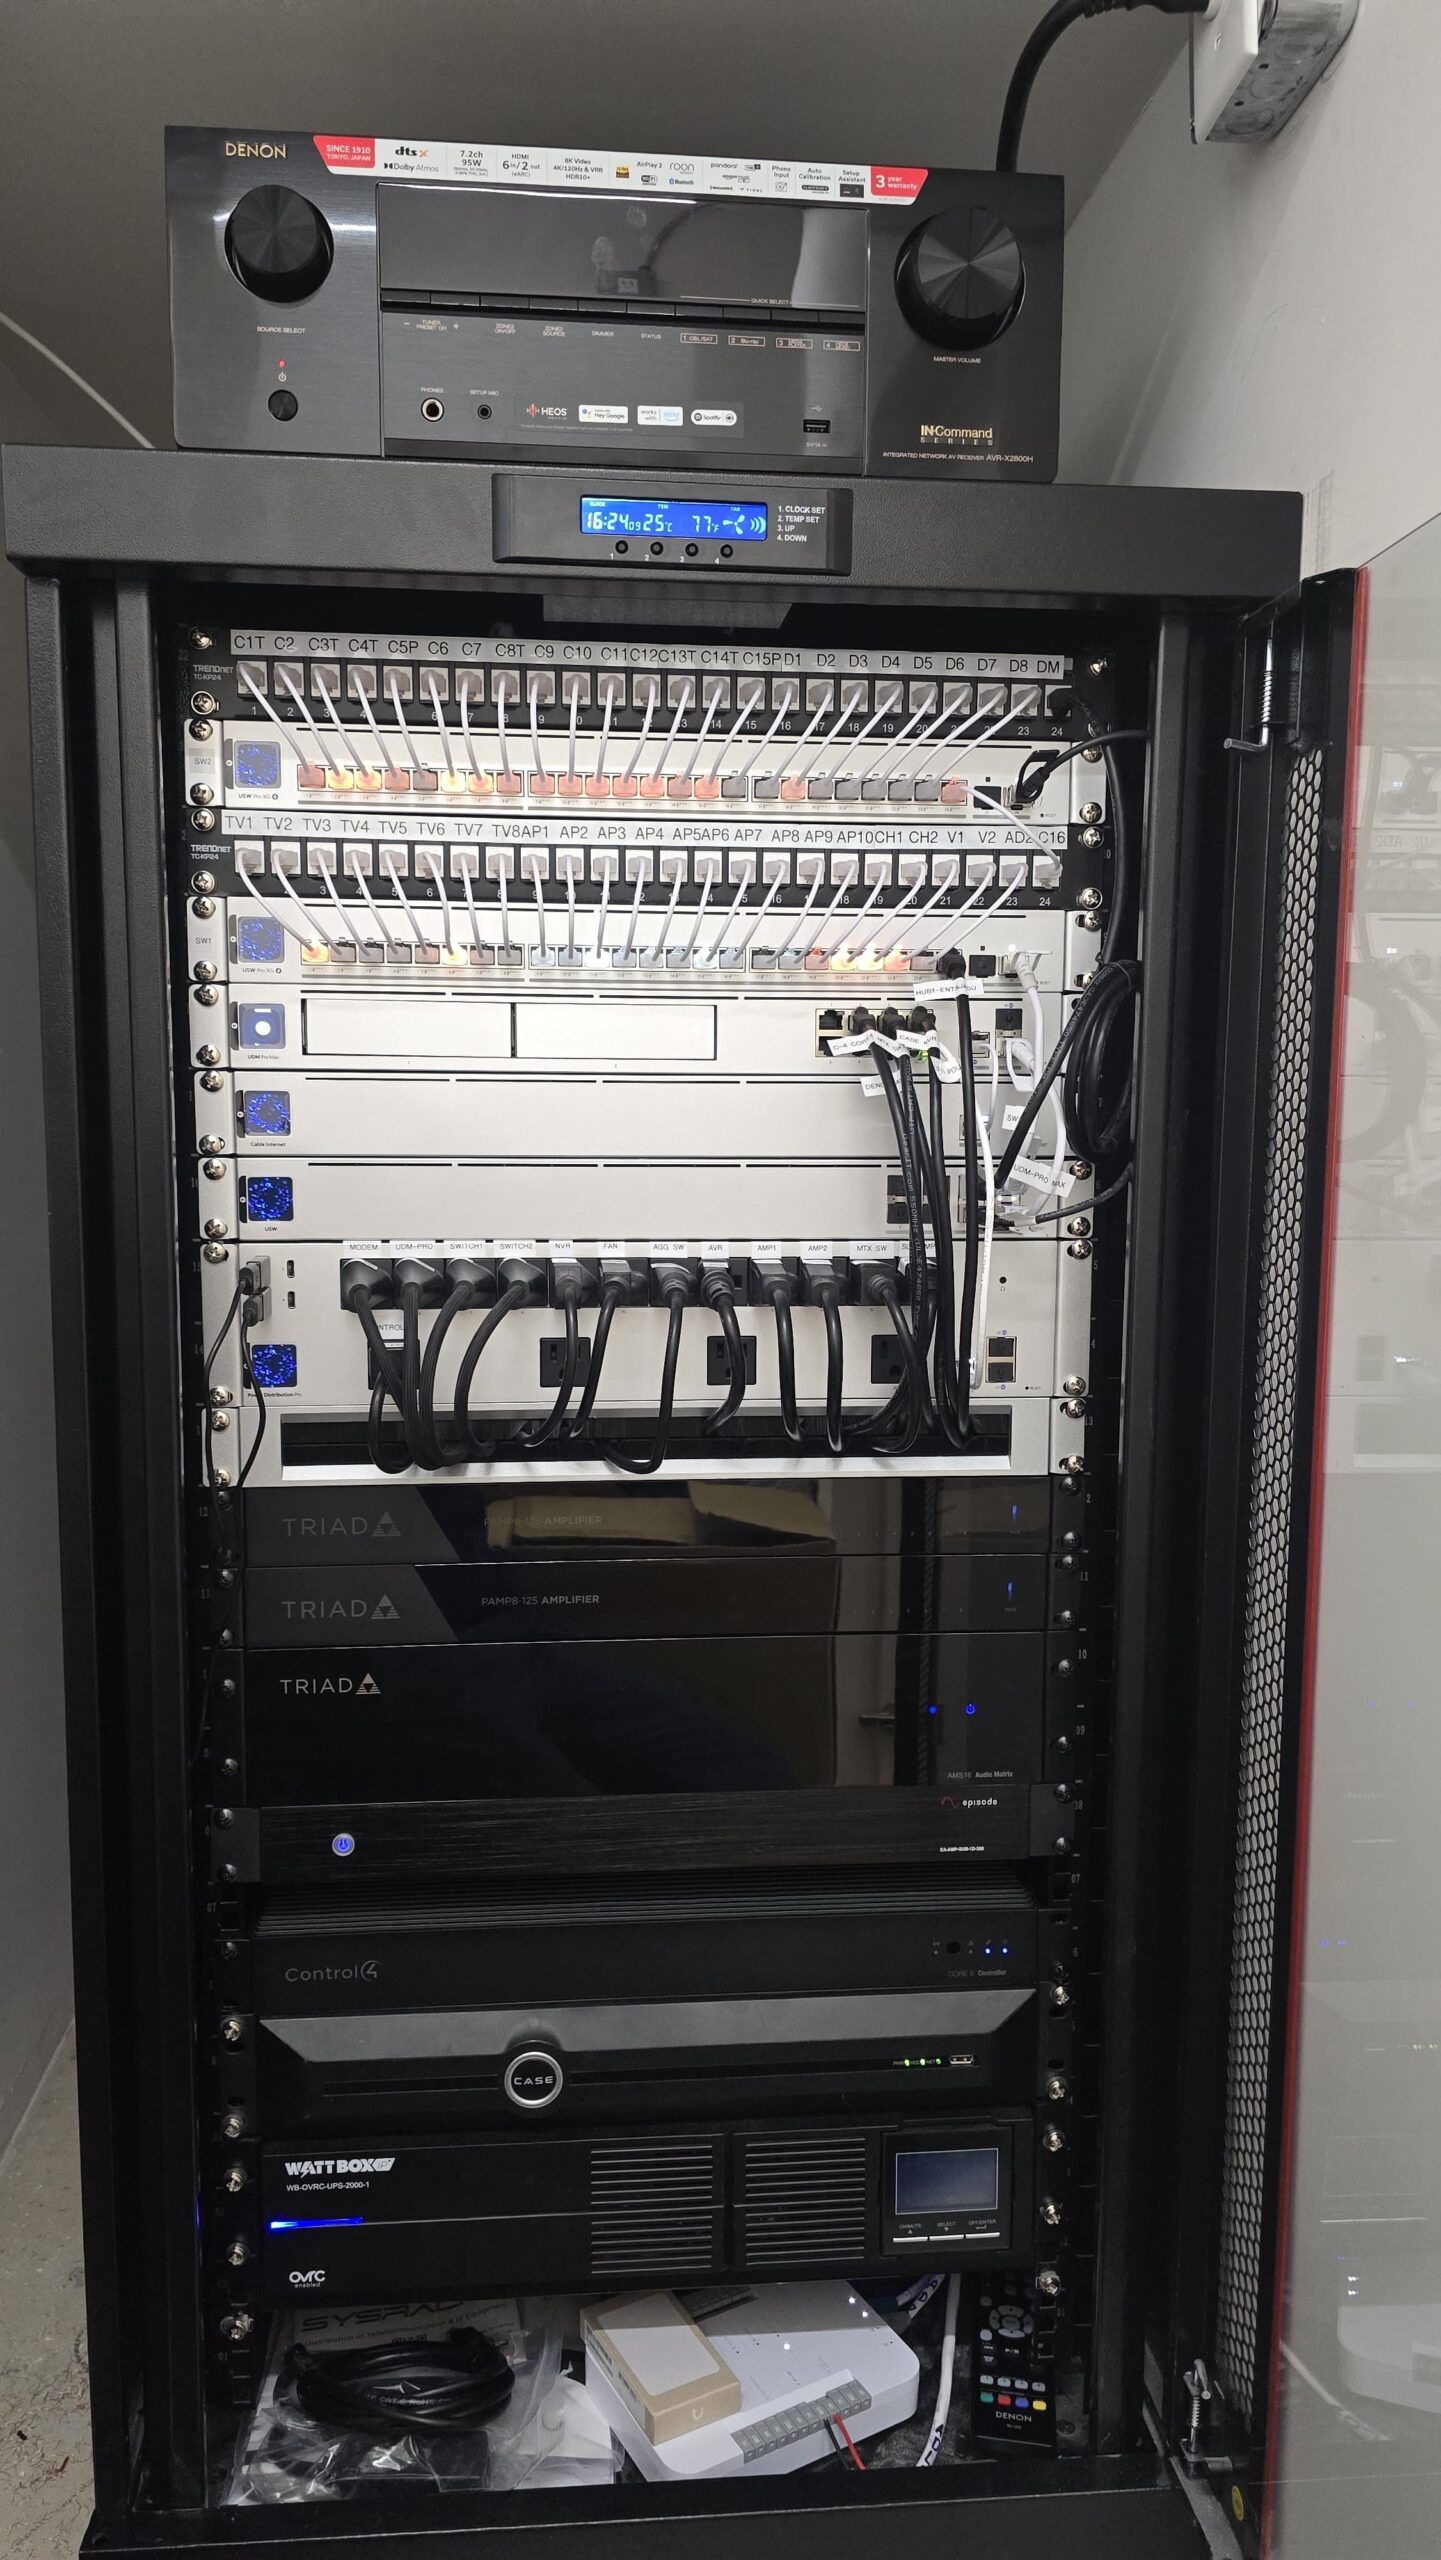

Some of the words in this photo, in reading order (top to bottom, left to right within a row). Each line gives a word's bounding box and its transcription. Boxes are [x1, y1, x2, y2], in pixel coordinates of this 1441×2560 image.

[225, 141, 286, 158] DENON
[326, 145, 350, 153] SINCE
[394, 163, 414, 171] Dolby
[416, 164, 438, 172] Atmos
[876, 175, 885, 188] 3
[542, 408, 567, 416] HEOS
[920, 437, 992, 445] SERIES
[986, 454, 1033, 462] AVR-X2800H
[586, 512, 629, 529] 16:24
[234, 636, 265, 649] C1T
[274, 637, 294, 650] C2
[308, 638, 339, 651] C3T
[348, 639, 378, 652] C4T
[388, 640, 419, 654] C5P
[428, 642, 448, 655] C6
[462, 643, 482, 656] C7
[495, 644, 525, 657] C8T
[534, 645, 554, 658] C9
[563, 646, 592, 659] C10
[601, 647, 627, 661] C11
[630, 648, 658, 662] C12
[659, 649, 696, 663] C13T
[701, 651, 739, 664] C14T
[743, 652, 781, 665] C15P
[784, 653, 800, 666] D1
[817, 654, 835, 667] D2
[850, 655, 867, 667] D3
[882, 656, 900, 668] D4
[914, 657, 932, 669] D5
[946, 658, 964, 670] D6
[978, 659, 996, 671] D7
[1010, 660, 1028, 673] D8
[1037, 660, 1060, 674] DM
[287, 708, 294, 716] 2
[711, 720, 722, 729] 14
[745, 721, 757, 729] 15
[780, 721, 791, 730] 16
[849, 723, 859, 732] 18
[883, 724, 893, 733] 19
[1018, 726, 1029, 736] 23
[1051, 727, 1063, 736] 24
[225, 816, 252, 829] TV1
[264, 817, 293, 831] TV2
[302, 818, 331, 832] TV3
[340, 820, 370, 832] TV4
[378, 821, 407, 834] TV5
[416, 822, 445, 835] TV6
[454, 823, 483, 837] TV7
[492, 825, 520, 838] TV8
[560, 827, 588, 839] AP2
[598, 827, 626, 839] AP3
[635, 828, 664, 840] AP4
[673, 828, 701, 841] AP5
[701, 828, 729, 841] AP6
[734, 829, 762, 842] AP7
[772, 830, 799, 843] AP8
[805, 831, 832, 843] AP9
[837, 831, 873, 844] AP10
[875, 831, 902, 844] CH1
[909, 831, 938, 844] CH2
[947, 832, 963, 844] V1
[979, 832, 996, 844] V2
[1039, 832, 1065, 844] C16
[320, 886, 326, 895] 3
[427, 888, 433, 897] 6
[1007, 897, 1018, 906] 23
[1039, 898, 1051, 906] 24
[900, 1035, 919, 1043] CASE
[1014, 1164, 1048, 1184] UDM-PRO
[544, 1515, 603, 1525] AMPLIFIER
[282, 1517, 368, 1538] TRIAD
[481, 1597, 538, 1606] PAMP8-125
[541, 1594, 600, 1604] AMPLIFIER
[282, 1600, 367, 1619] TRIAD
[1078, 1650, 1087, 1659] 10
[280, 1678, 352, 1695] TRIAD
[962, 1798, 998, 1808] episode
[286, 1960, 382, 1982] Control4
[514, 2076, 554, 2085] CASE
[286, 2181, 370, 2191] WB-OVRC-UPS-2000-1
[295, 2281, 321, 2289] enabled
[995, 2411, 1032, 2422] DENON
